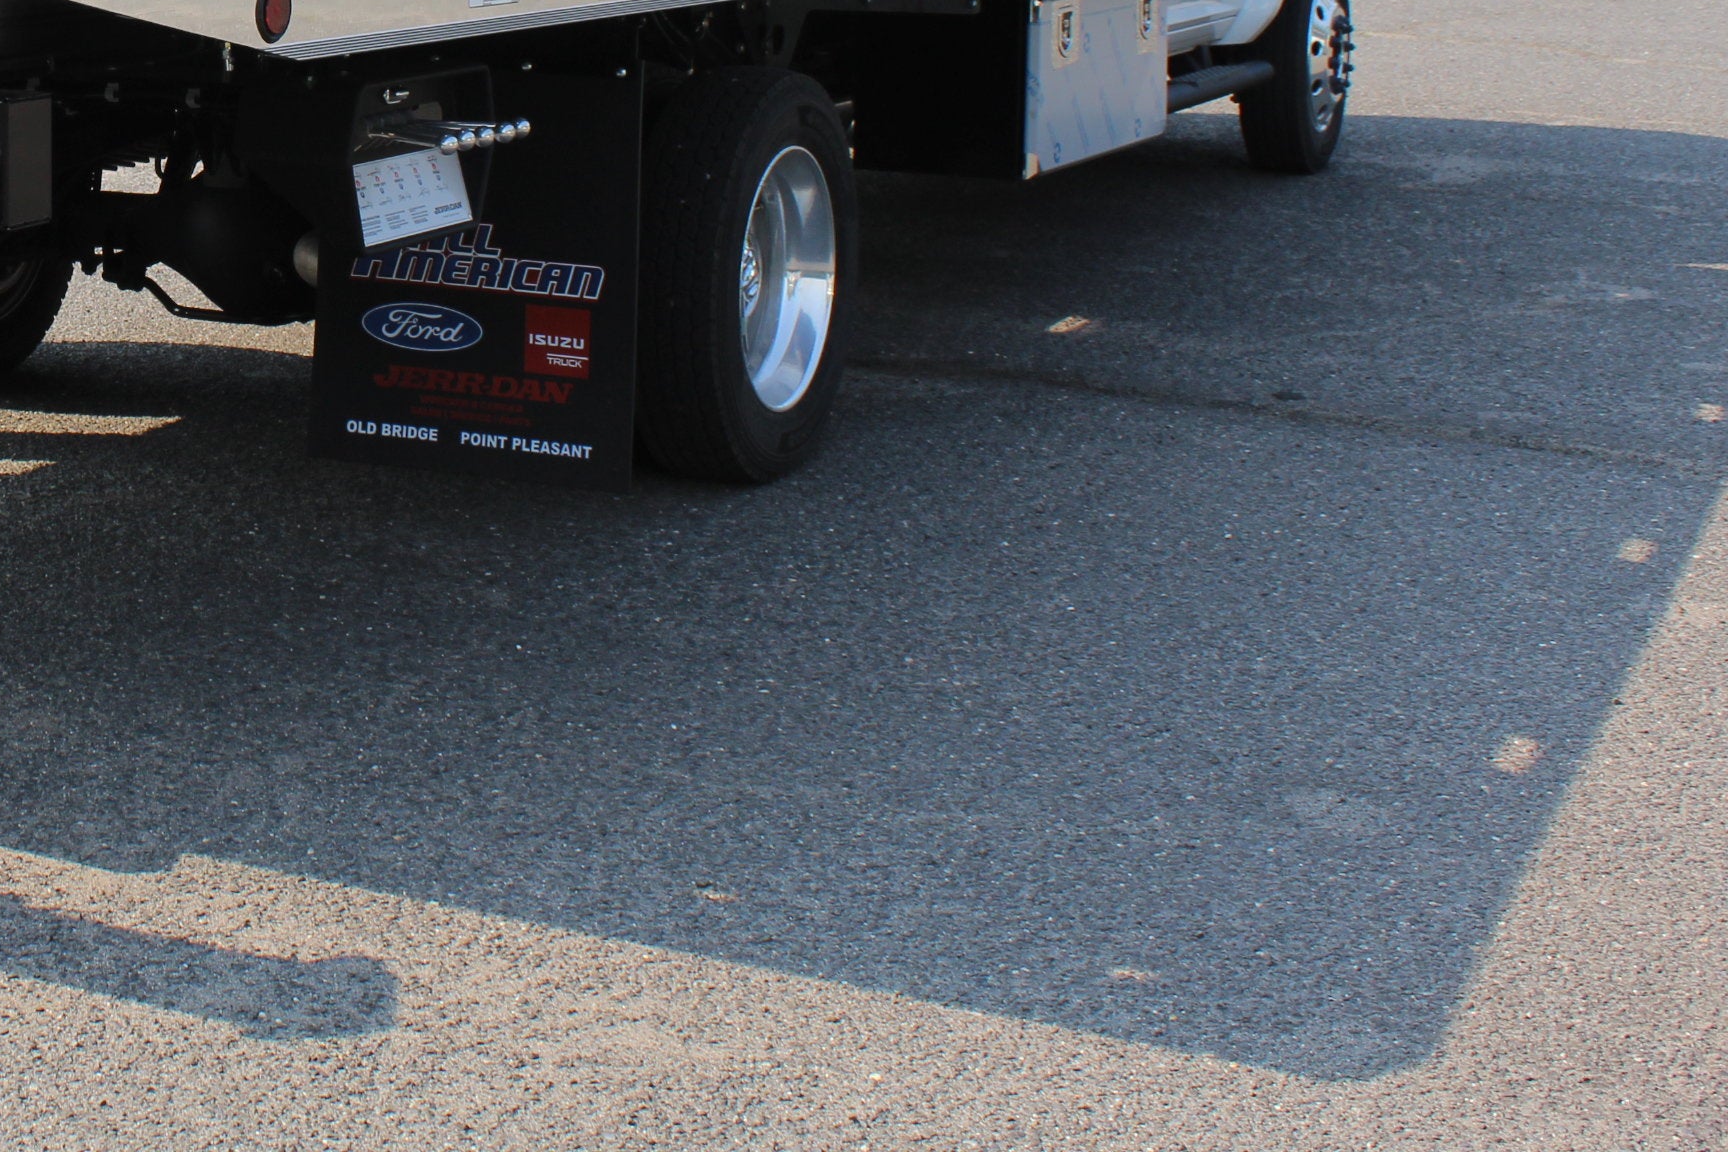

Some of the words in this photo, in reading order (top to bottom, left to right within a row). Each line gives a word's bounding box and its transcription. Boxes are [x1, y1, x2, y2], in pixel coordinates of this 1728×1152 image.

[350, 248, 605, 301] AMERICAN
[382, 309, 462, 343] Ford
[529, 332, 585, 351] ISUZU
[547, 356, 583, 369] TRUCK
[346, 419, 378, 436] OLD
[381, 422, 439, 442] BRIDGE
[460, 431, 508, 450] POINT
[512, 437, 593, 460] PLEASANT
